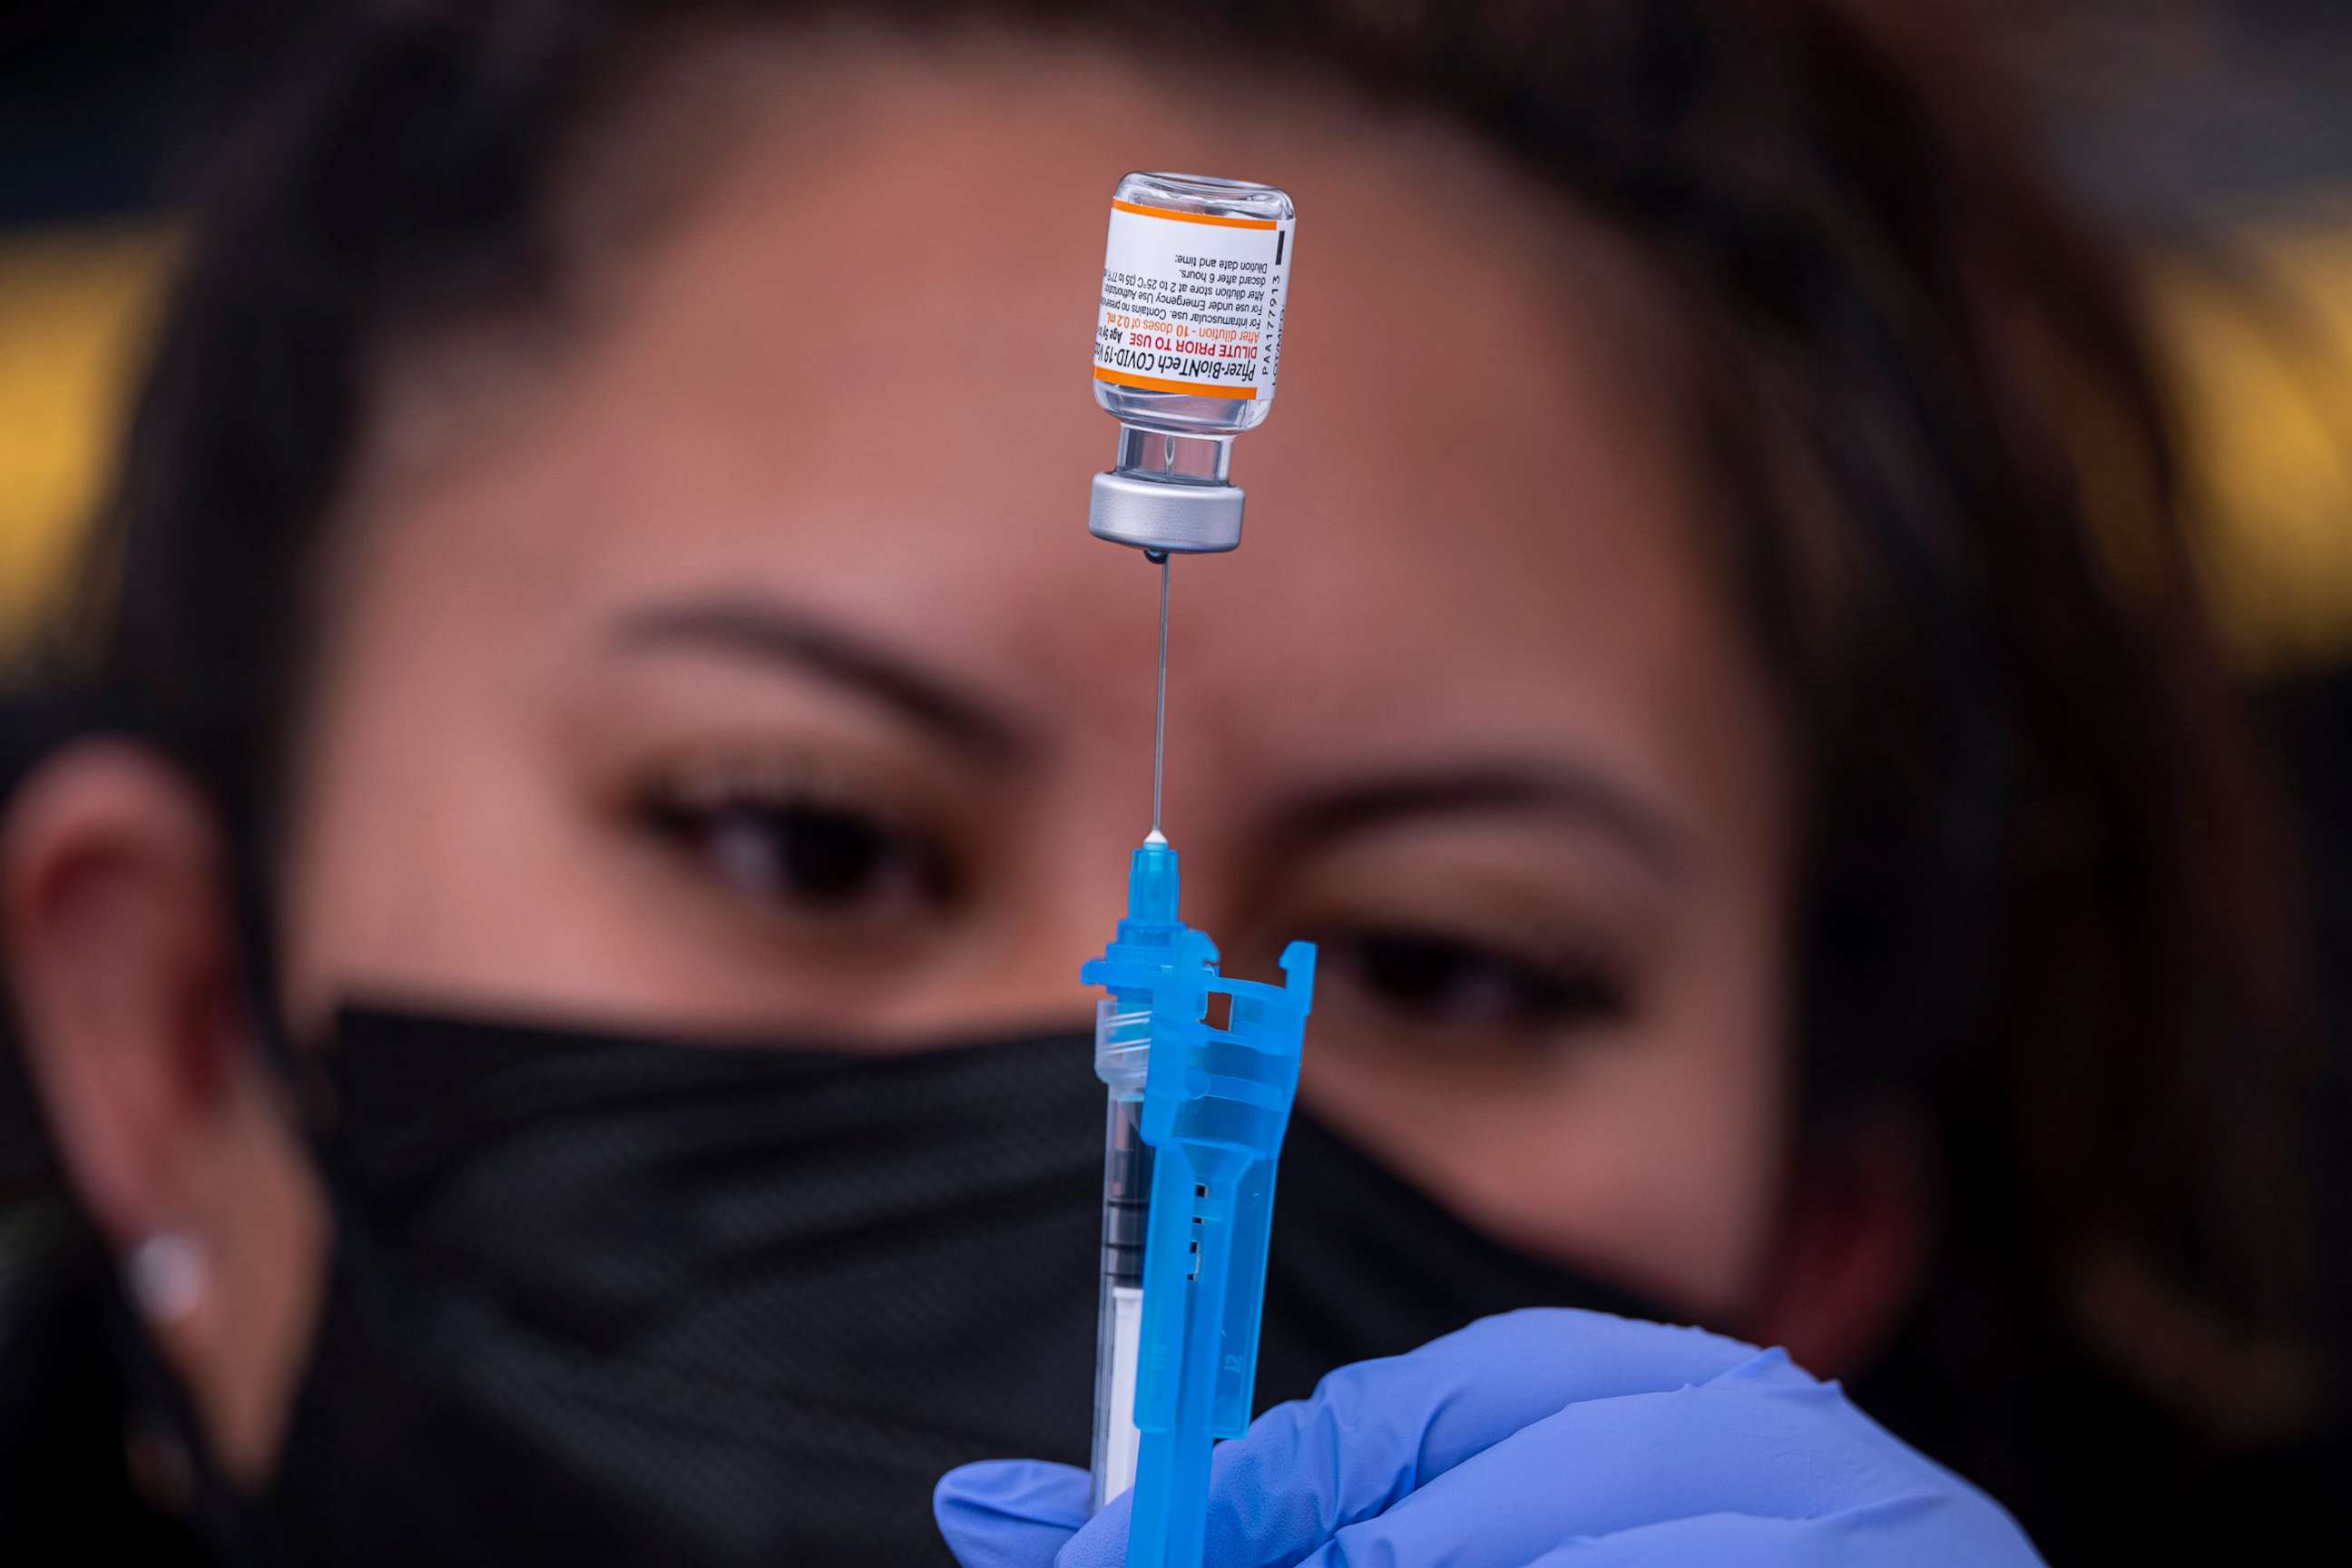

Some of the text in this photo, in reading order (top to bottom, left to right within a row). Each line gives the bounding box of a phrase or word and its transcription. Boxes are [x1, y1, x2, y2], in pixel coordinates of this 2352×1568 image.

[1174, 255, 1268, 274] Dilution date and time:
[1119, 273, 1124, 283] to
[1125, 274, 1136, 286] (35
[1137, 277, 1157, 289] 25°C
[1179, 270, 1267, 288] discard after 6 hours.
[1159, 280, 1168, 290] to
[1170, 282, 1177, 293] 2
[1179, 283, 1188, 293] at
[1190, 285, 1213, 296] store
[1138, 292, 1153, 304] Use
[1216, 288, 1246, 300] dilution
[1247, 290, 1264, 301] After
[1156, 291, 1206, 310] Emergency
[1208, 301, 1233, 312] under
[1121, 302, 1130, 312] no
[1132, 304, 1167, 320] Contains
[1235, 304, 1250, 313] use
[1250, 304, 1262, 315] For
[1106, 312, 1116, 324] mL
[1117, 316, 1130, 328] 0.2
[1169, 311, 1188, 321] use.
[1190, 313, 1248, 328] intramuscular
[1131, 318, 1141, 330] of
[1142, 319, 1172, 335] doses
[1250, 318, 1261, 329] For
[1261, 275, 1280, 376] PAA177913
[1110, 328, 1122, 344] Age
[1176, 325, 1189, 337] 10
[1199, 327, 1237, 343] dilution
[1238, 330, 1259, 344] After
[1130, 333, 1258, 359] DILUTE PRIOR TO USE
[1104, 346, 1154, 371] COVID-19
[1158, 355, 1256, 382] Pfizer-BioNTech
